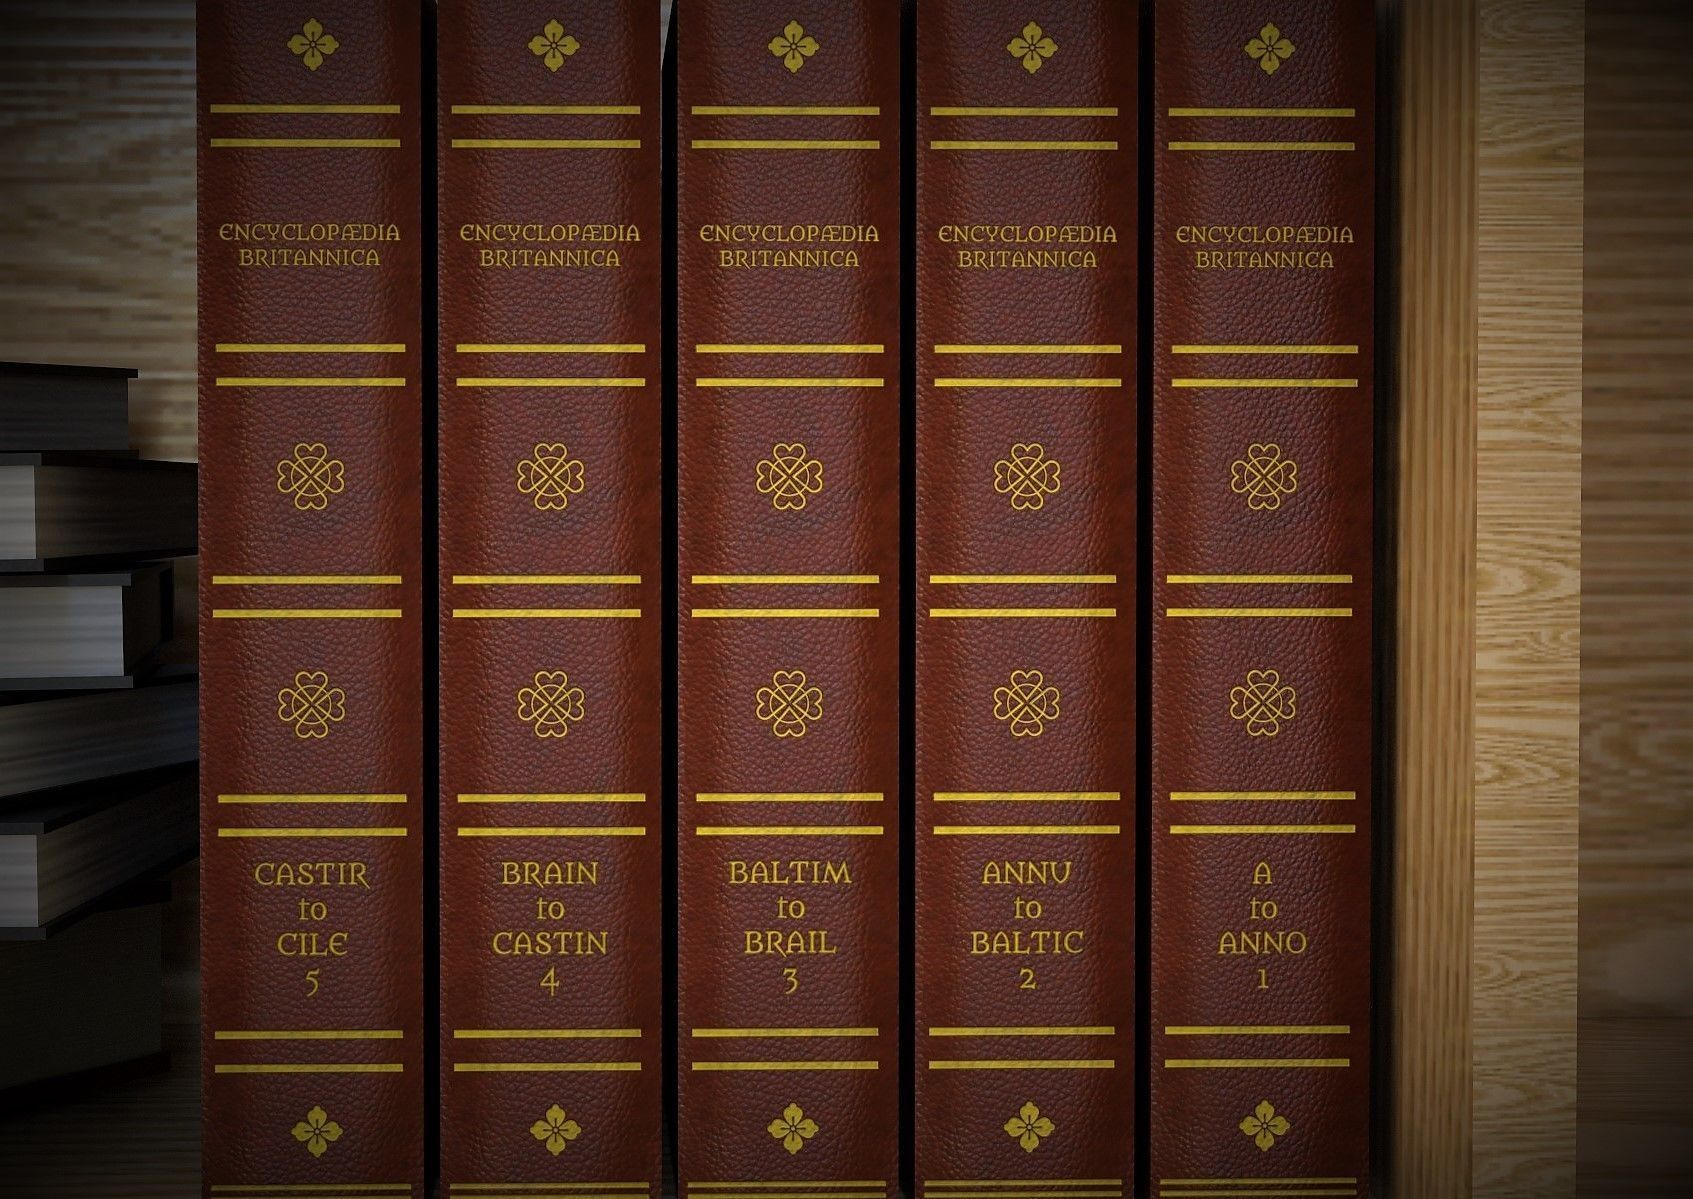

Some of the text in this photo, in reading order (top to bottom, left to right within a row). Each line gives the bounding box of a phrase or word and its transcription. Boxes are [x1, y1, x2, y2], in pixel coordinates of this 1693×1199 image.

[219, 223, 401, 242] ENCYCLOPÆDIA
[460, 223, 641, 243] ENCYCLOPÆDIA
[700, 224, 880, 244] ENCYCLOPÆDIA
[938, 224, 1118, 244] ENCYCLOPÆDIA
[1175, 225, 1354, 244] ENCYCLOPÆDIA
[239, 248, 381, 268] BRITANNICA
[480, 248, 620, 269] BRITANNICA
[719, 249, 859, 270] BRITANNICA
[957, 249, 1097, 270] BRITANNICA
[1195, 250, 1334, 271] BRITANNICA
[254, 861, 370, 889] CASTIR
[500, 860, 600, 888] BRAIN
[727, 860, 852, 885] BALTIM
[1252, 861, 1273, 885] A
[298, 898, 328, 921] to
[536, 896, 566, 921] to
[776, 895, 806, 919] to
[1013, 895, 1043, 919] to
[1249, 896, 1279, 919] to
[276, 931, 350, 957] CILE
[491, 930, 609, 956] CASTIN
[743, 930, 838, 958] BRAIL
[969, 930, 1085, 955] BALTIC
[1217, 930, 1307, 955] ANNO
[305, 968, 320, 997] 5
[539, 967, 561, 997] 4
[782, 967, 799, 994] 3
[1019, 967, 1038, 990] 2
[1257, 968, 1269, 989] 1
